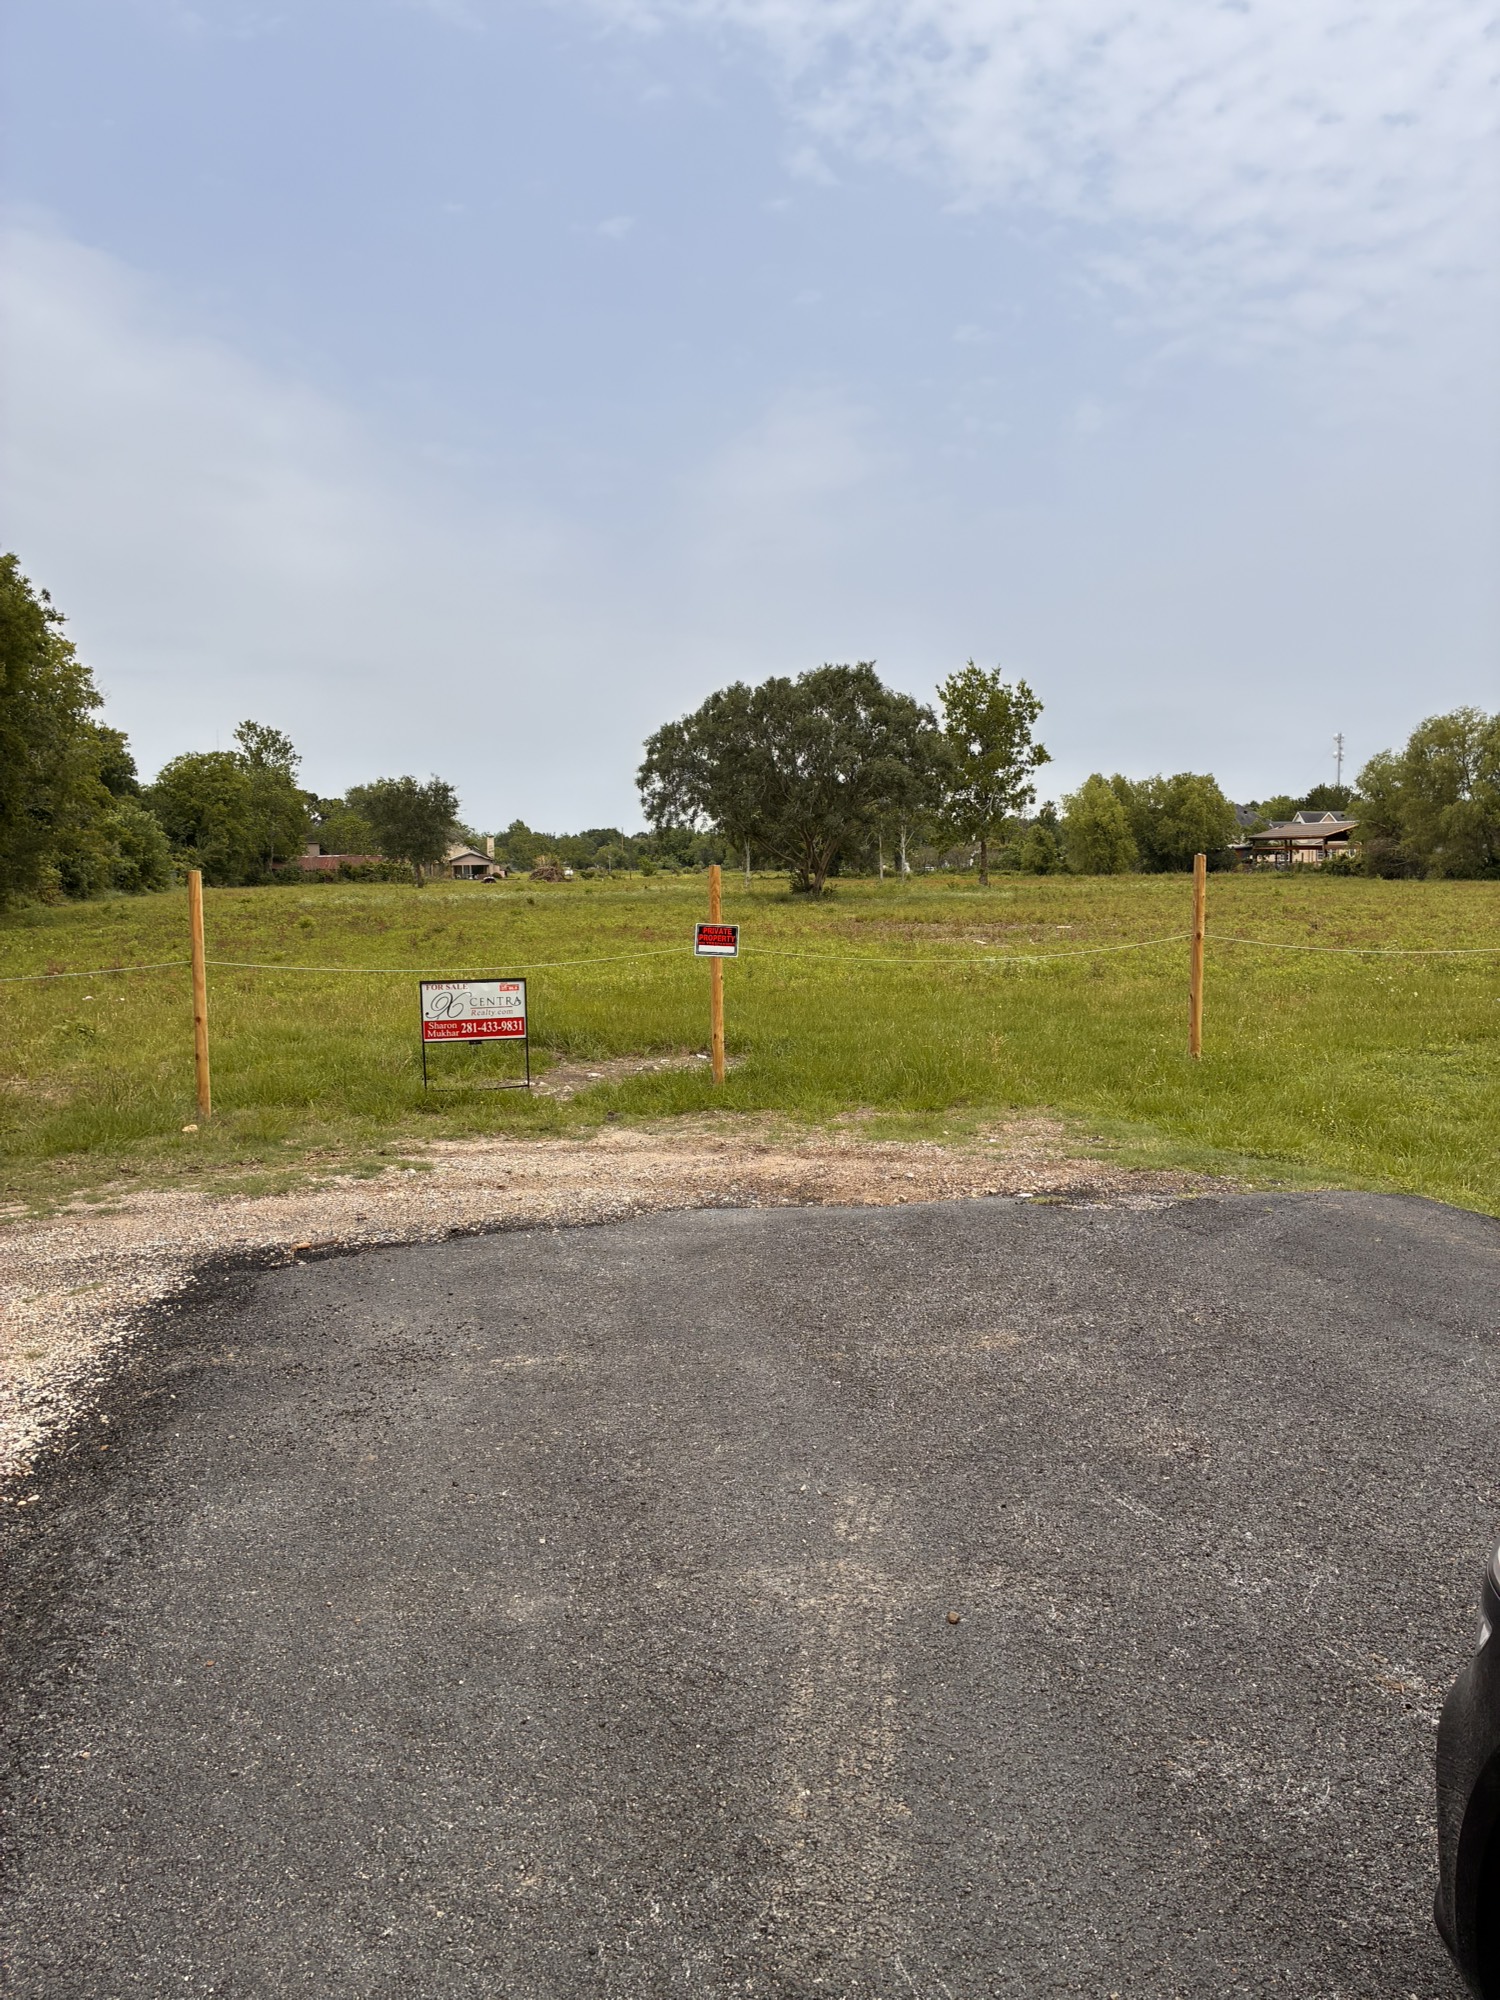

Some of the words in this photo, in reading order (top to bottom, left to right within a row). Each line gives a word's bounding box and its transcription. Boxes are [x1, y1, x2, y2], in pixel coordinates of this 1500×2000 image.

[702, 927, 733, 935] PRIVATE
[698, 934, 735, 942] PROPERTY
[469, 996, 521, 1006] CENTRA
[428, 1021, 458, 1030] Sharon
[460, 1020, 523, 1034] 281-433-9831
[427, 1029, 459, 1038] Mukhar
